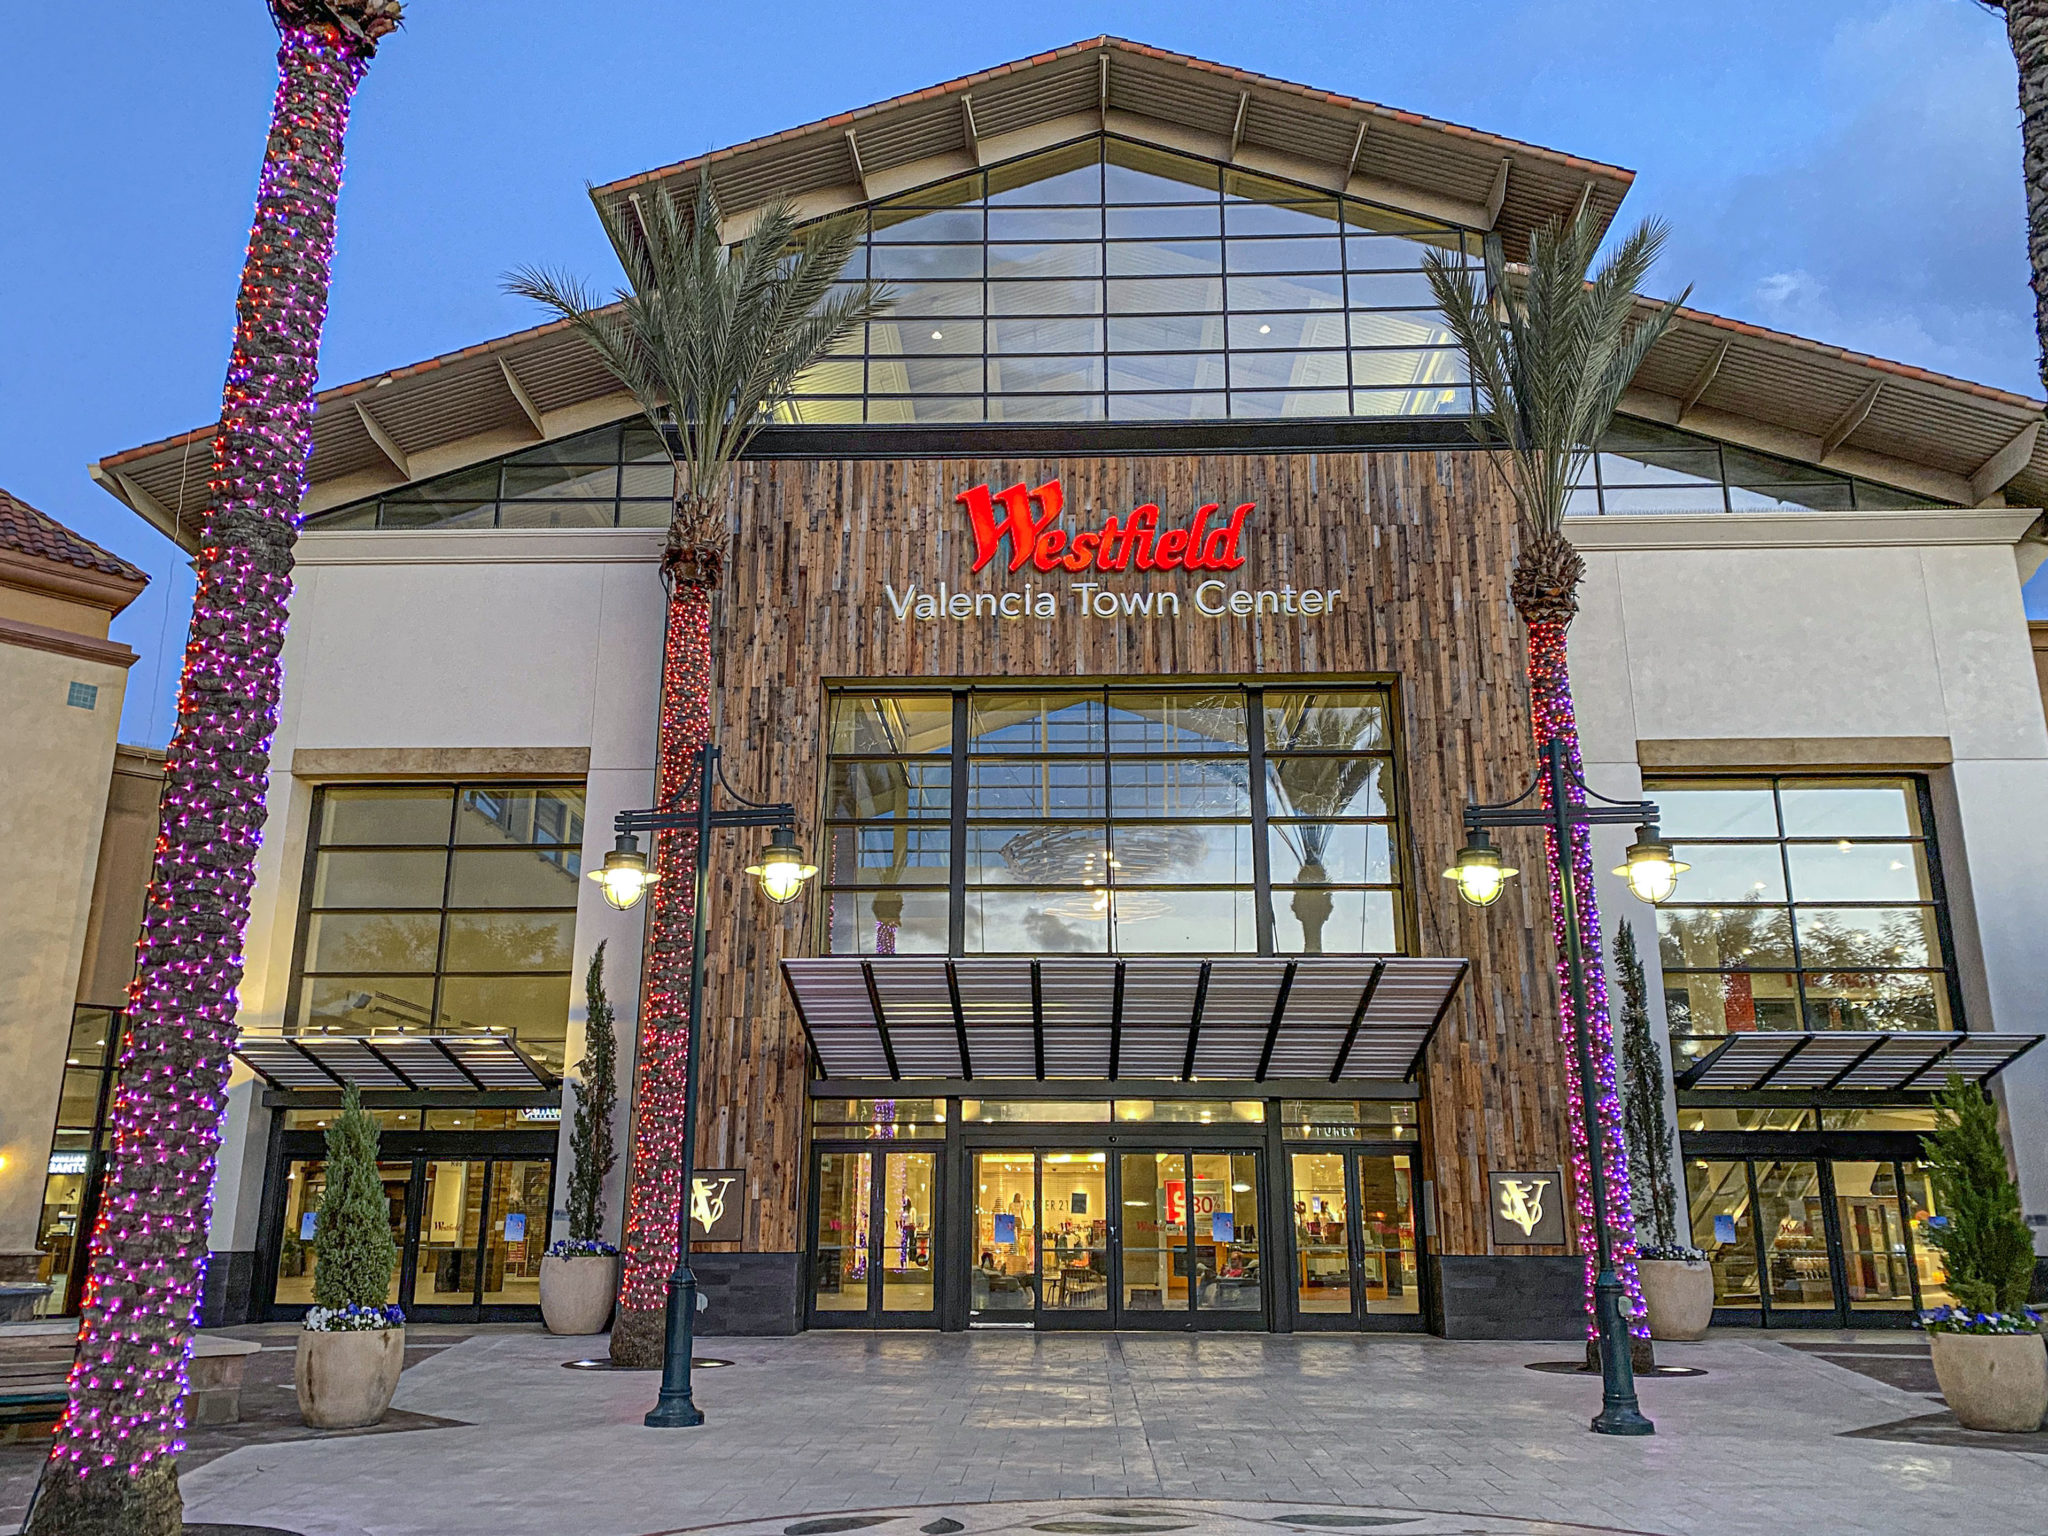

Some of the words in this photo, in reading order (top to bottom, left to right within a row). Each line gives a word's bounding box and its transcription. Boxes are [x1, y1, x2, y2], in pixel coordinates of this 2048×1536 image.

[956, 478, 1256, 574] Westfield
[885, 582, 1056, 619] Valencia
[1071, 582, 1179, 618] Town
[1196, 580, 1341, 618] Center
